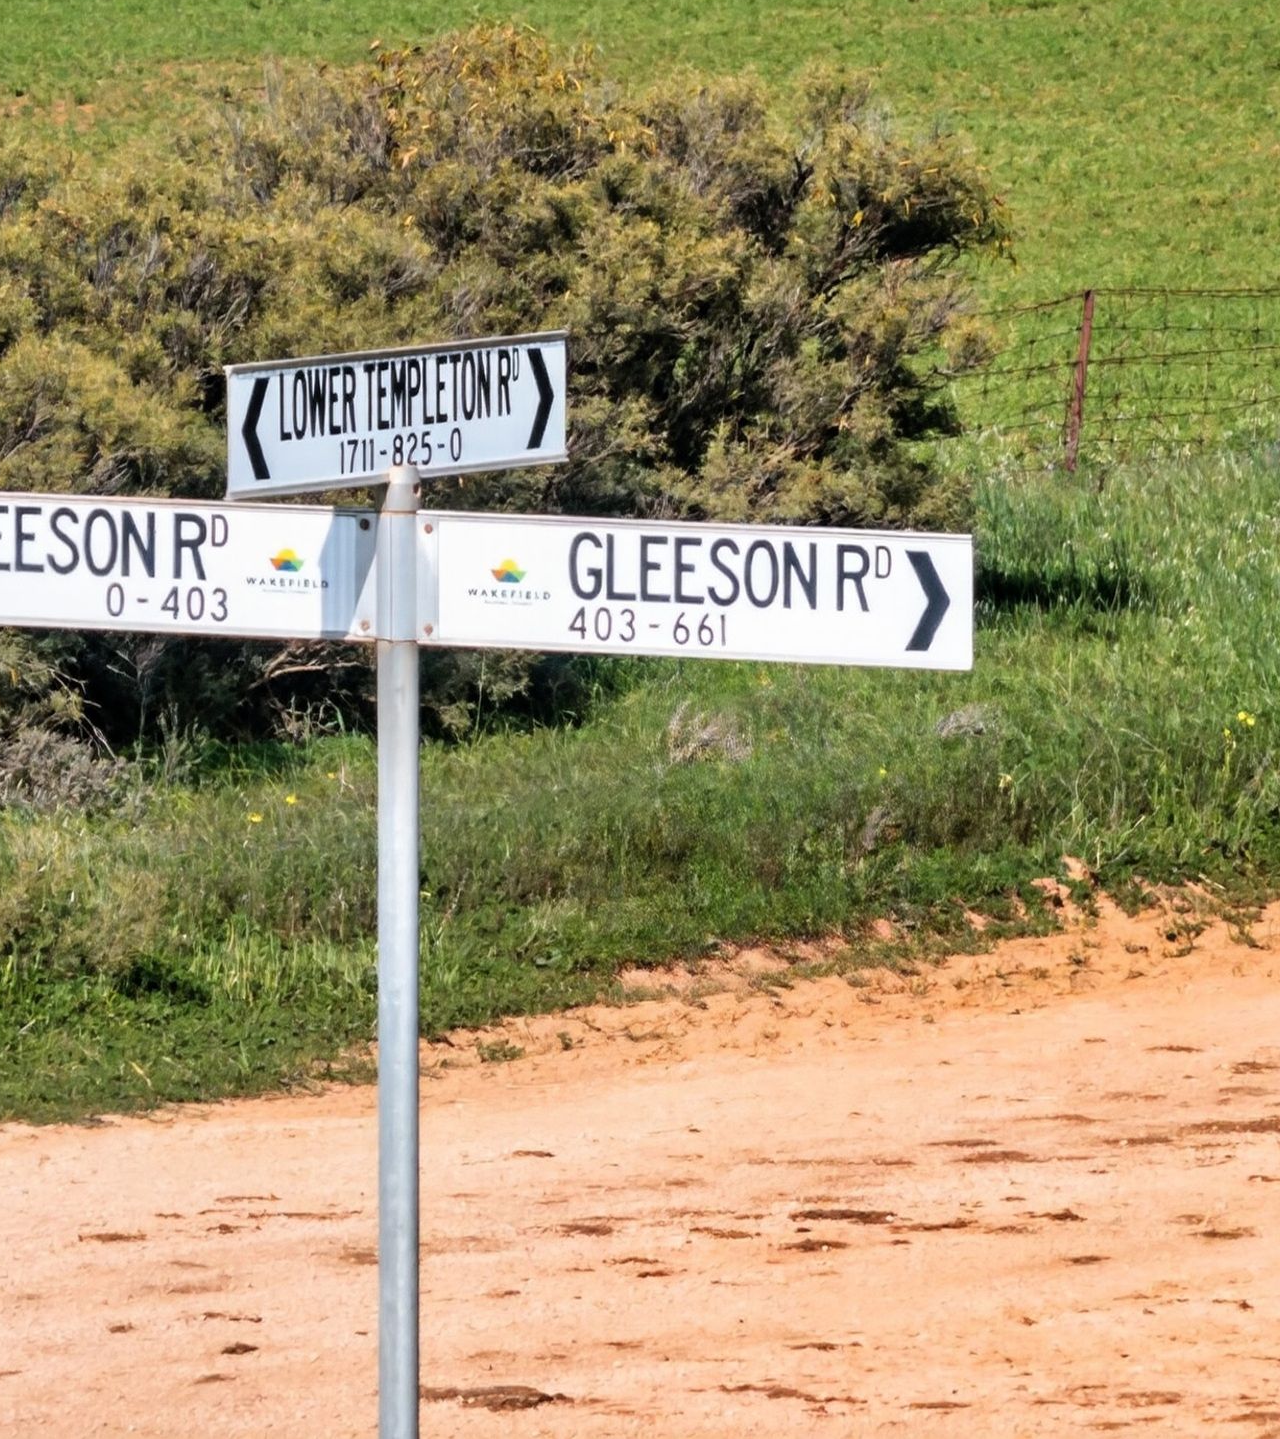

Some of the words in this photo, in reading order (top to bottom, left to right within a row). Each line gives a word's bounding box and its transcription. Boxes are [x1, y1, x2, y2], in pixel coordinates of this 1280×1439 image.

[279, 364, 357, 441] LOWER
[363, 349, 491, 432] TEMPLETON
[340, 427, 463, 475] 1711-825-0
[246, 577, 329, 588] WAKEFIELD
[468, 589, 551, 600] WAKEFIELD
[569, 532, 817, 610] GLEESON
